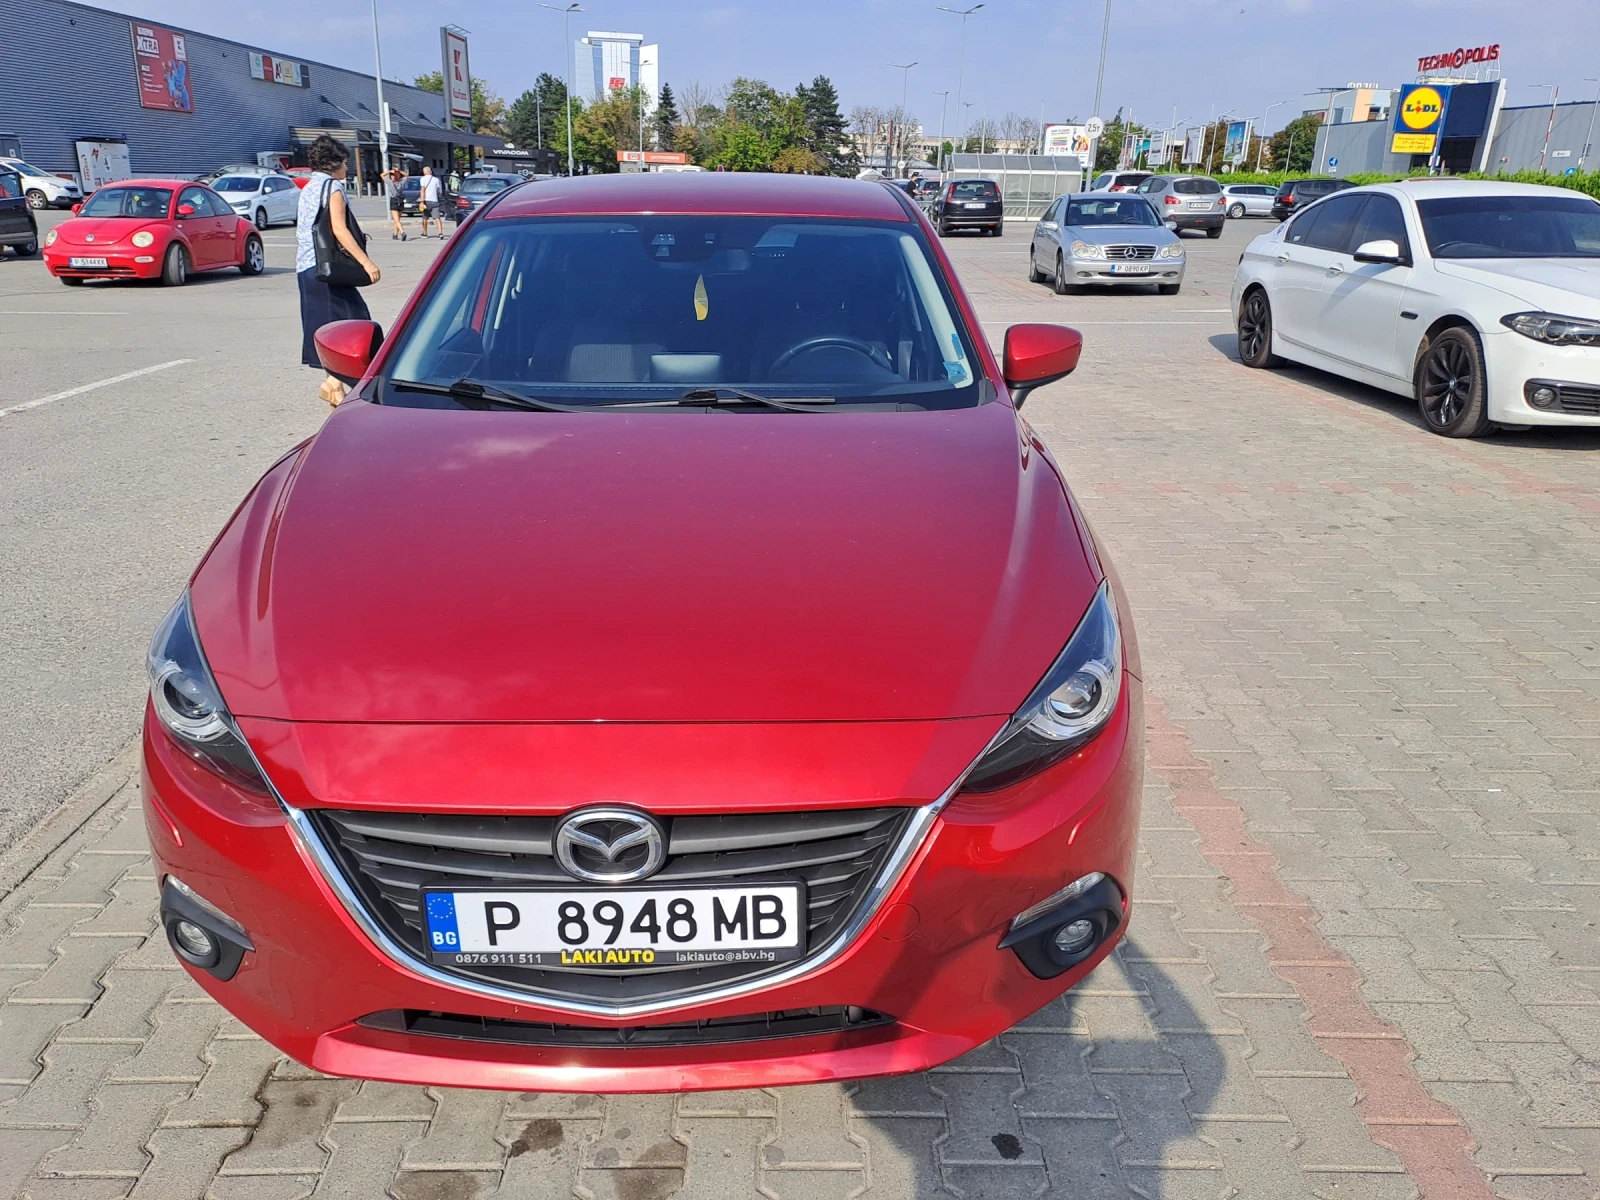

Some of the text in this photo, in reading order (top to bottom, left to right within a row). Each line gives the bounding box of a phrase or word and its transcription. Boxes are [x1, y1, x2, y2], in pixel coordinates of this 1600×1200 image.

[1418, 44, 1500, 72] TECHNOPOLIS
[484, 894, 787, 946] P 8948 MB
[432, 931, 457, 945] BG
[455, 949, 775, 964] 0876 911 511 LAKI AUTO lakiauto@abv.bg
